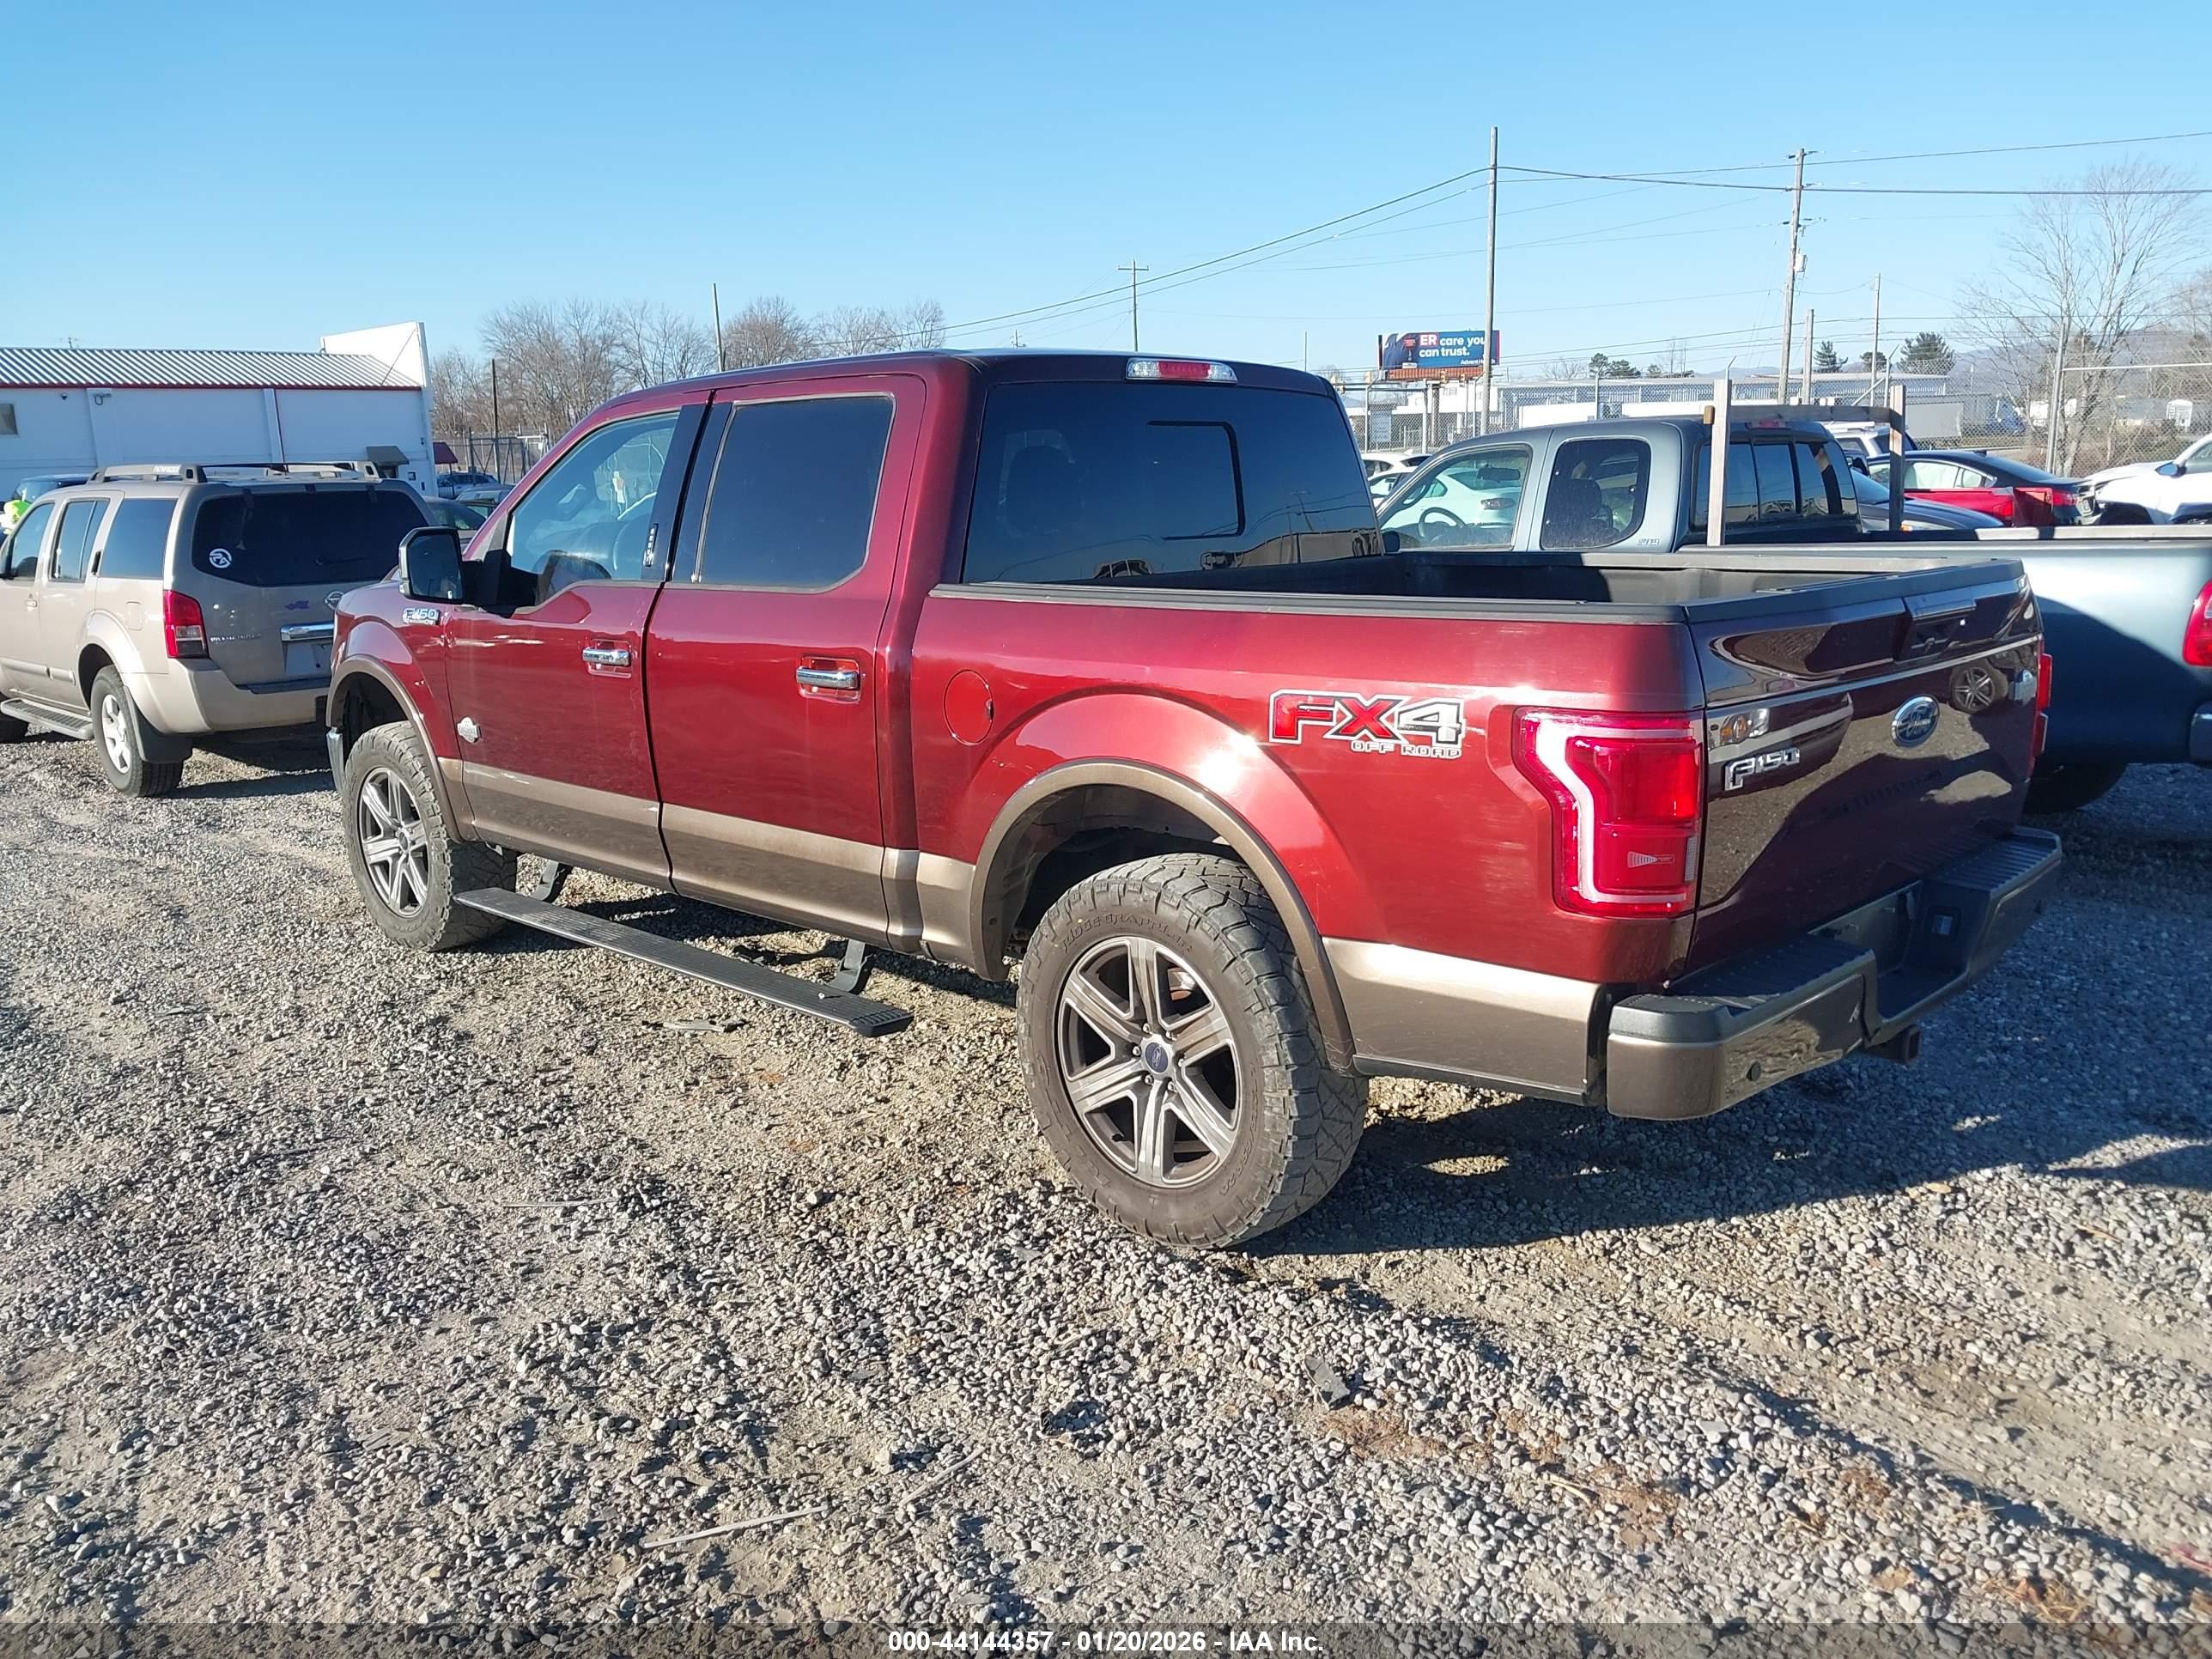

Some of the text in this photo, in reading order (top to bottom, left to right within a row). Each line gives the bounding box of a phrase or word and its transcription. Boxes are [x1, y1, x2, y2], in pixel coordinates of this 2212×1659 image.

[1419, 334, 1437, 346] ER
[1439, 337, 1465, 346] care
[1419, 346, 1470, 358] can trust.
[1269, 690, 1465, 747] FX4
[1351, 740, 1462, 759] OFF ROAD
[1725, 748, 1800, 791] F150
